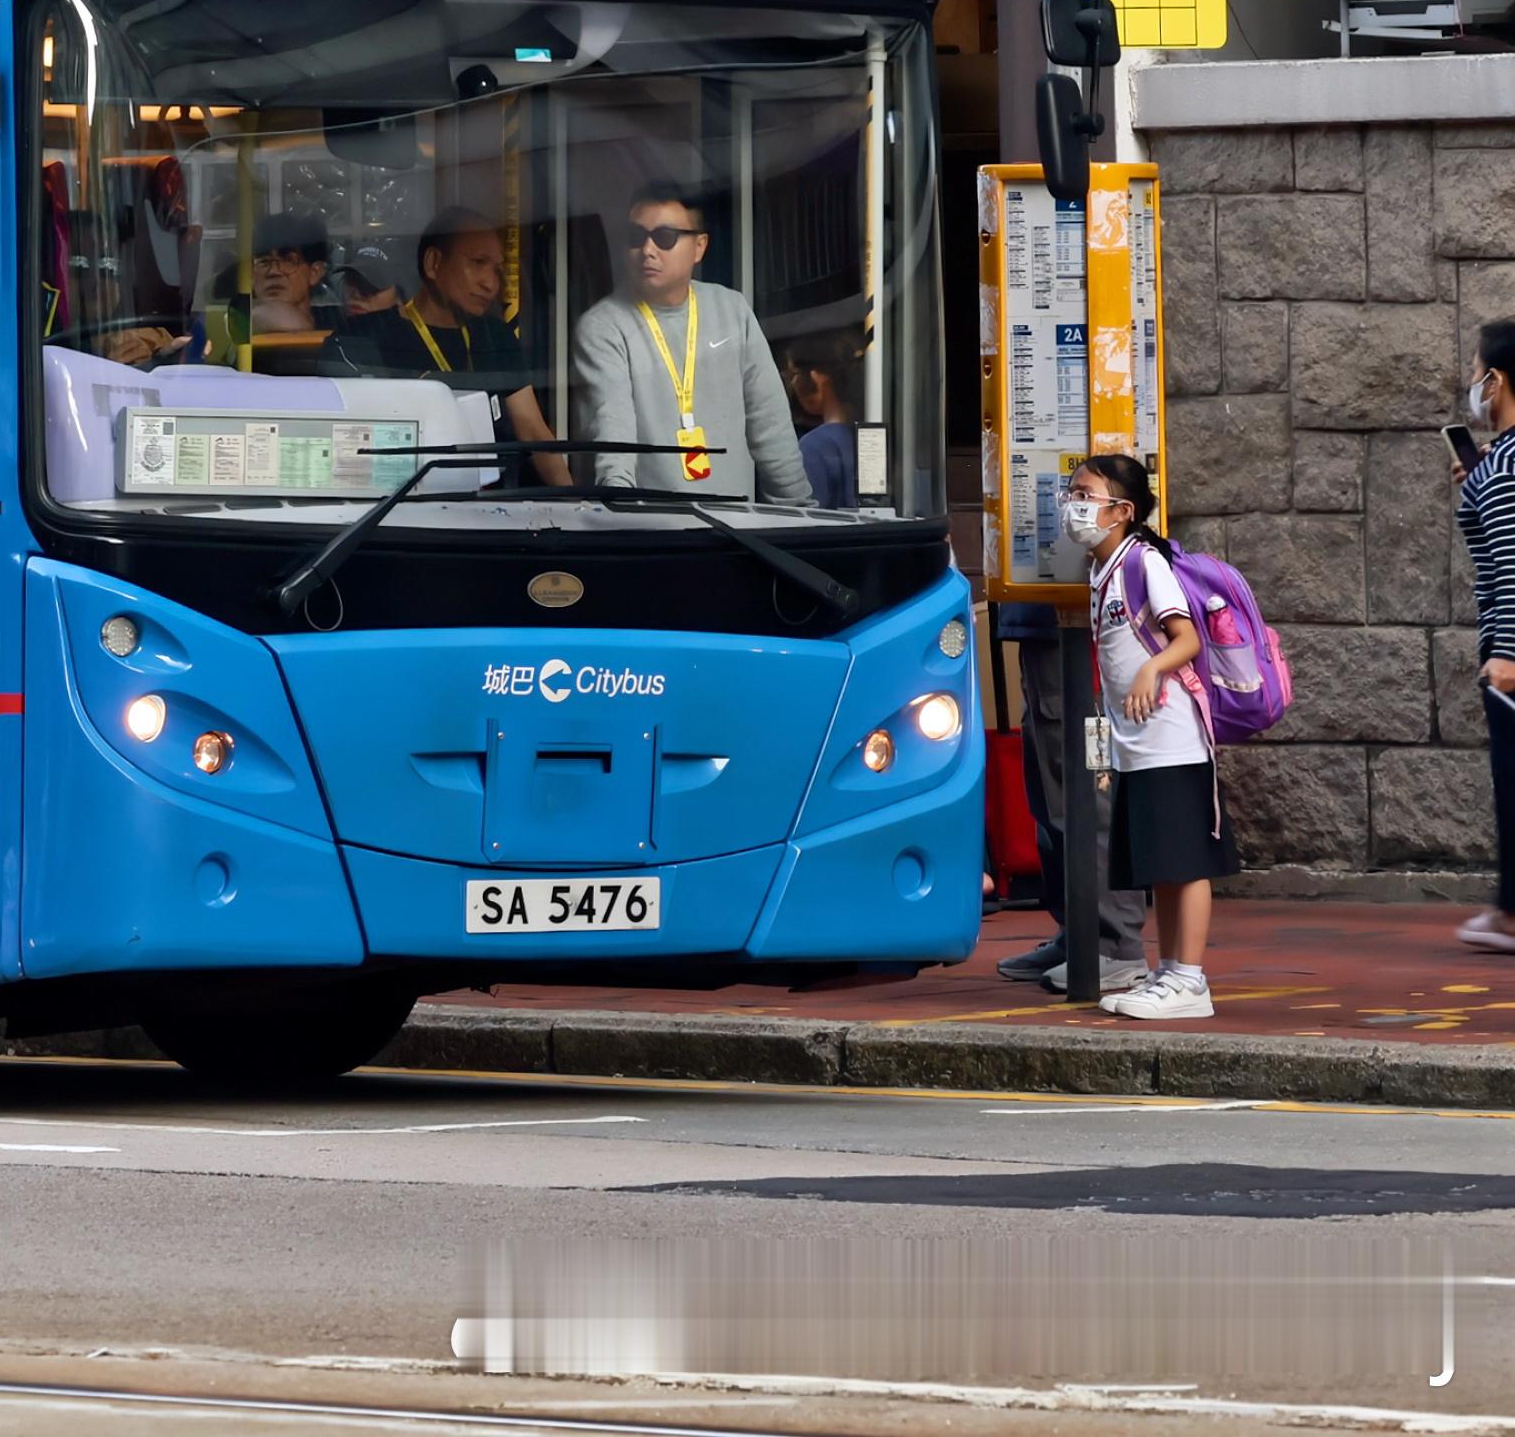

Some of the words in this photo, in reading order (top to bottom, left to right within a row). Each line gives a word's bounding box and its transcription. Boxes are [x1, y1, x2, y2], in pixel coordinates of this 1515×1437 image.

[1064, 327, 1083, 342] 2A
[482, 664, 534, 695] 城巴
[576, 666, 665, 697] Citybus
[481, 886, 529, 925] SA
[548, 884, 648, 924] 5476
